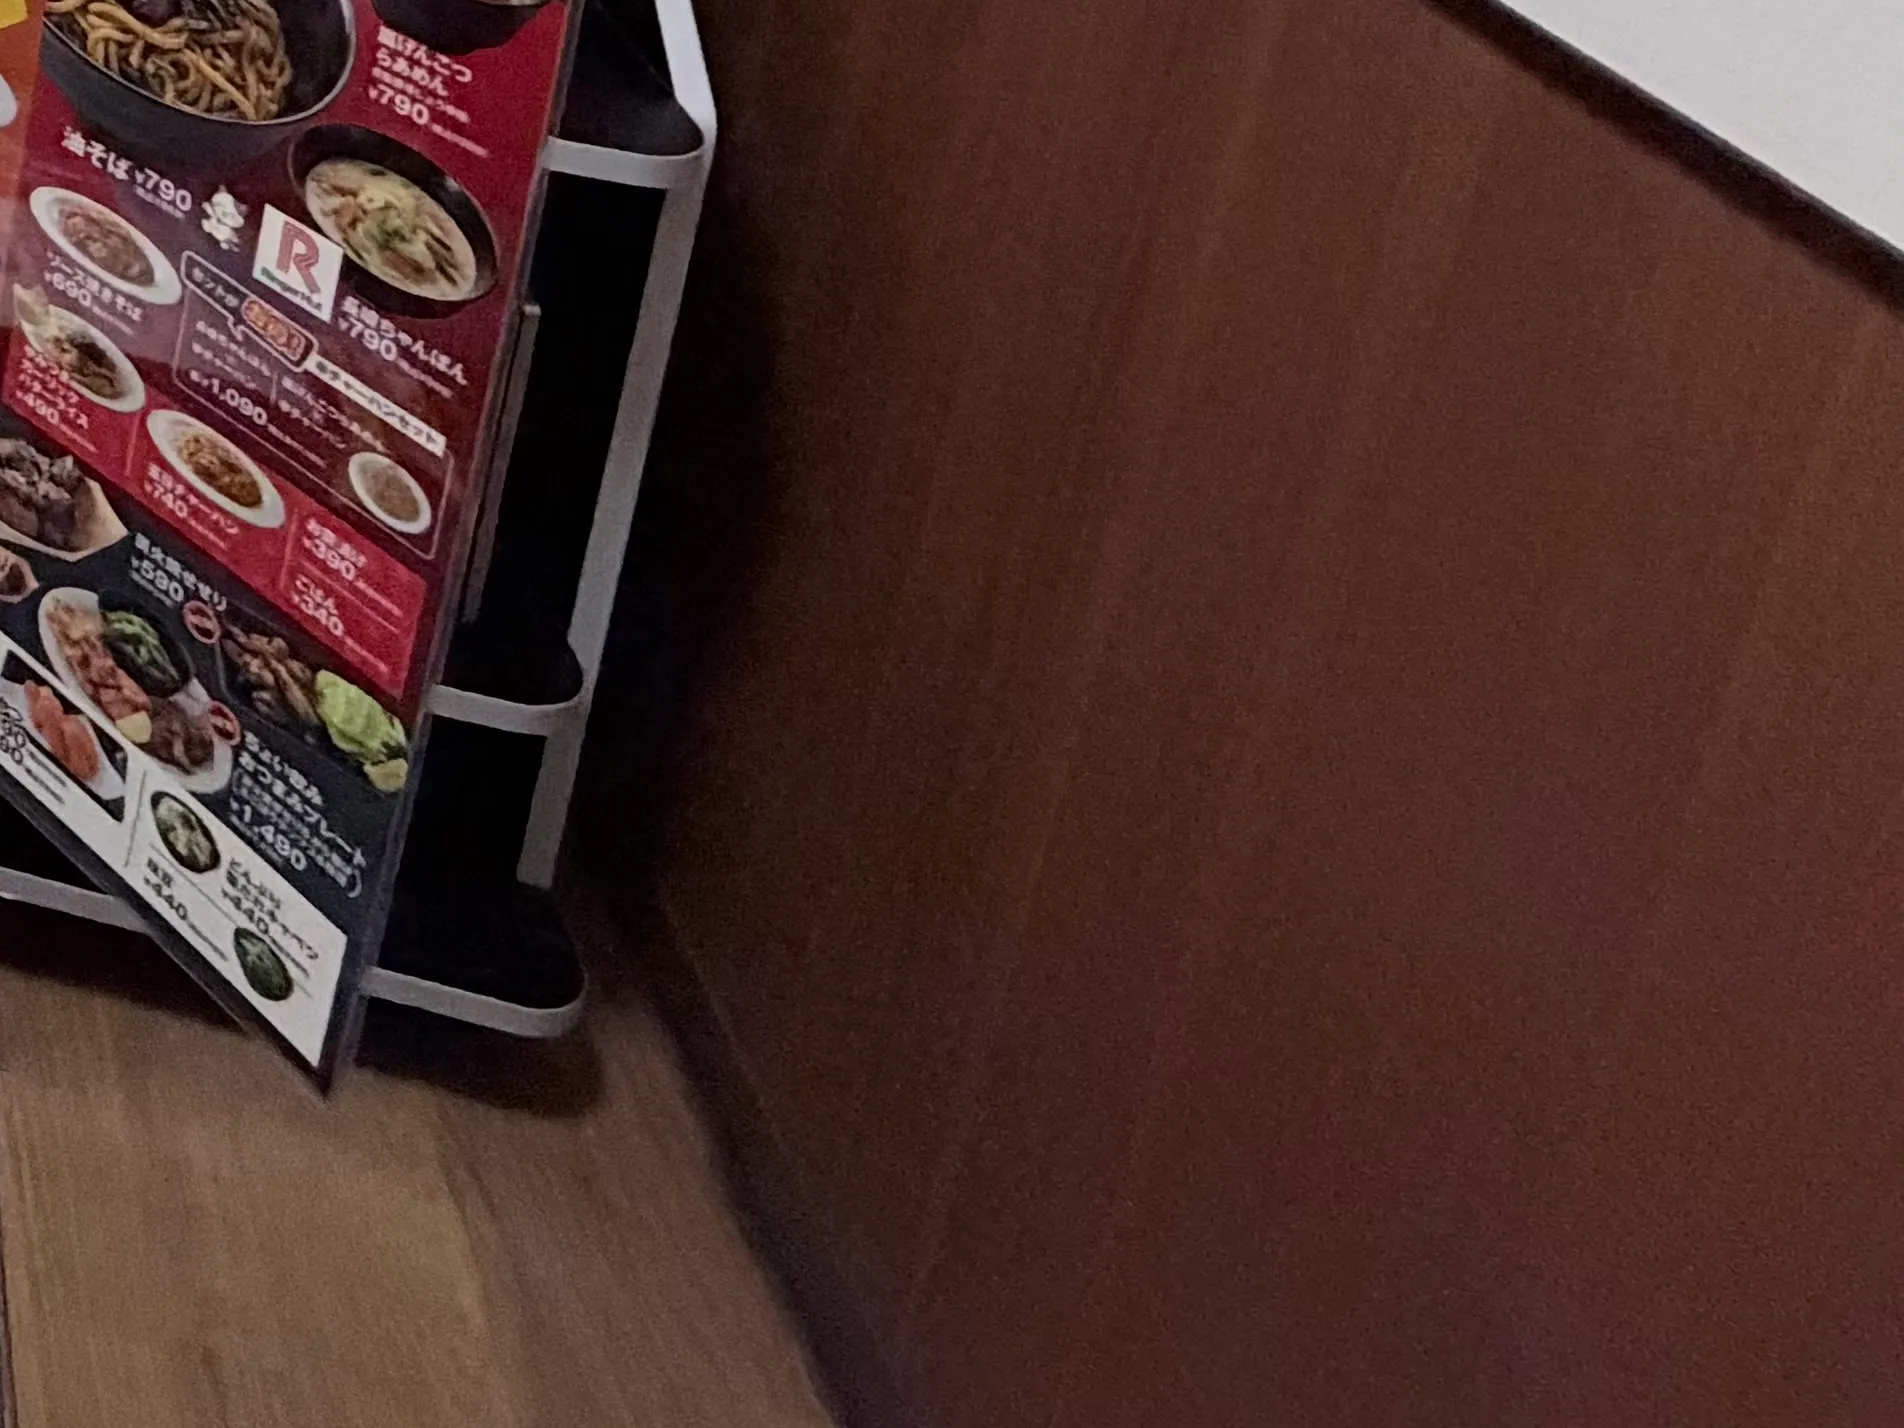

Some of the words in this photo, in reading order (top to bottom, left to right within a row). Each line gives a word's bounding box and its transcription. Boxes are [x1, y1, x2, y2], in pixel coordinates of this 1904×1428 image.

[367, 82, 430, 126] ¥790
[134, 166, 193, 213] ¥790
[338, 315, 398, 363] ¥790
